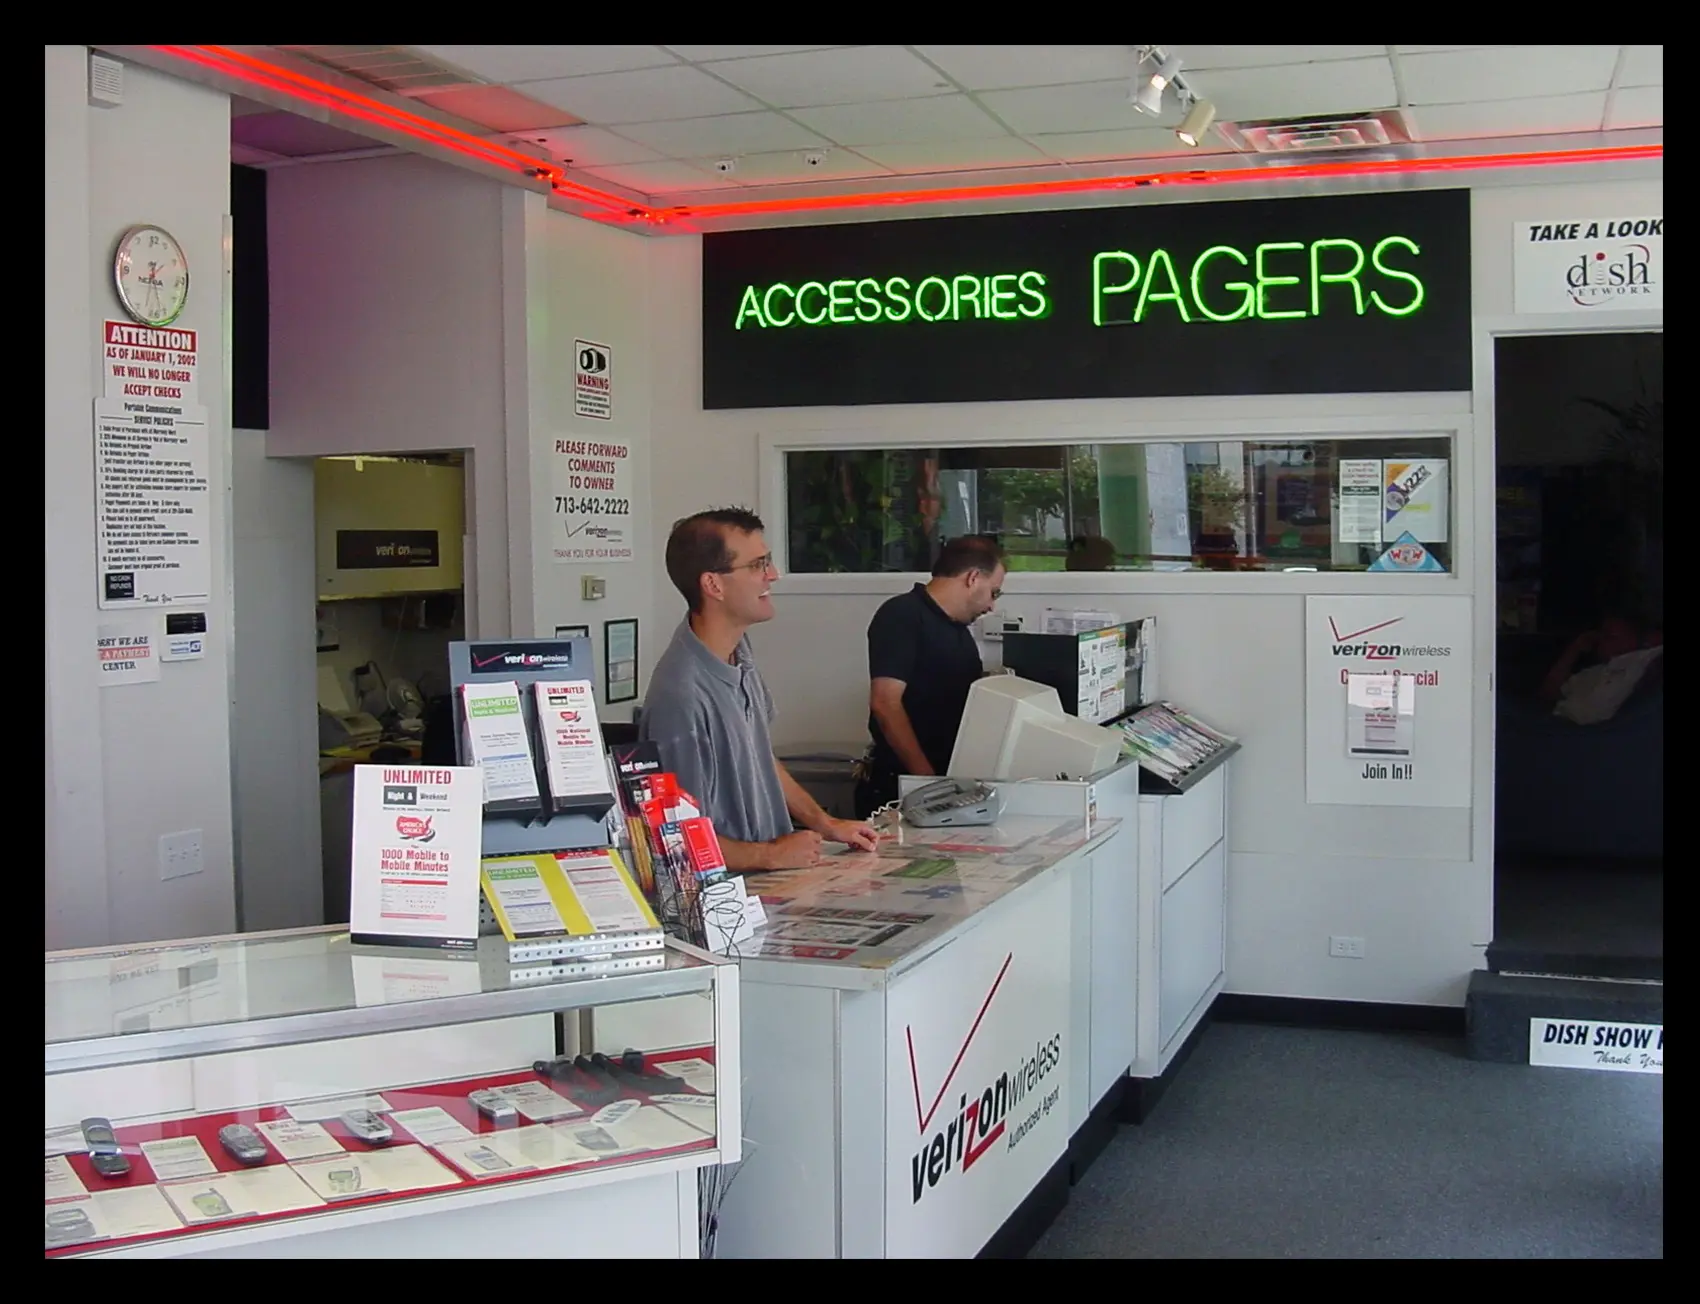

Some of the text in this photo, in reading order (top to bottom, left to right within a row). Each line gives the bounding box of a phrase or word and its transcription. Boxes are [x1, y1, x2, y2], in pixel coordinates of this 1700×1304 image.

[1529, 218, 1663, 242] TAKE A LOOK
[1566, 252, 1650, 288] dish
[735, 236, 1424, 330] ACCESSORIES PAGERS
[1566, 286, 1652, 297] NETWORK
[111, 325, 192, 349] ATTENTION
[106, 347, 117, 359] AS
[119, 348, 129, 360] OF
[131, 350, 166, 364] JANUARY
[177, 354, 196, 366] 2002
[112, 365, 191, 383] WE WILL NO LONGER
[577, 373, 609, 390] WARNING
[123, 384, 182, 399] ACCEPT CHECKS
[555, 440, 628, 458] PLEASE FORWARD
[568, 458, 615, 474] COMMENTS
[569, 476, 615, 490] TO OWNER
[102, 661, 136, 671] CENTER
[383, 769, 451, 785] UNLIMITED
[1362, 763, 1413, 780] Join In!!
[381, 848, 450, 861] 1000 Mobile to
[380, 859, 449, 872] Mobile Minutes
[1543, 1023, 1589, 1045] DISH
[1593, 1026, 1653, 1049] SHOW
[1593, 1051, 1631, 1065] Thank
[1007, 1084, 1060, 1153] Authorized Agent
